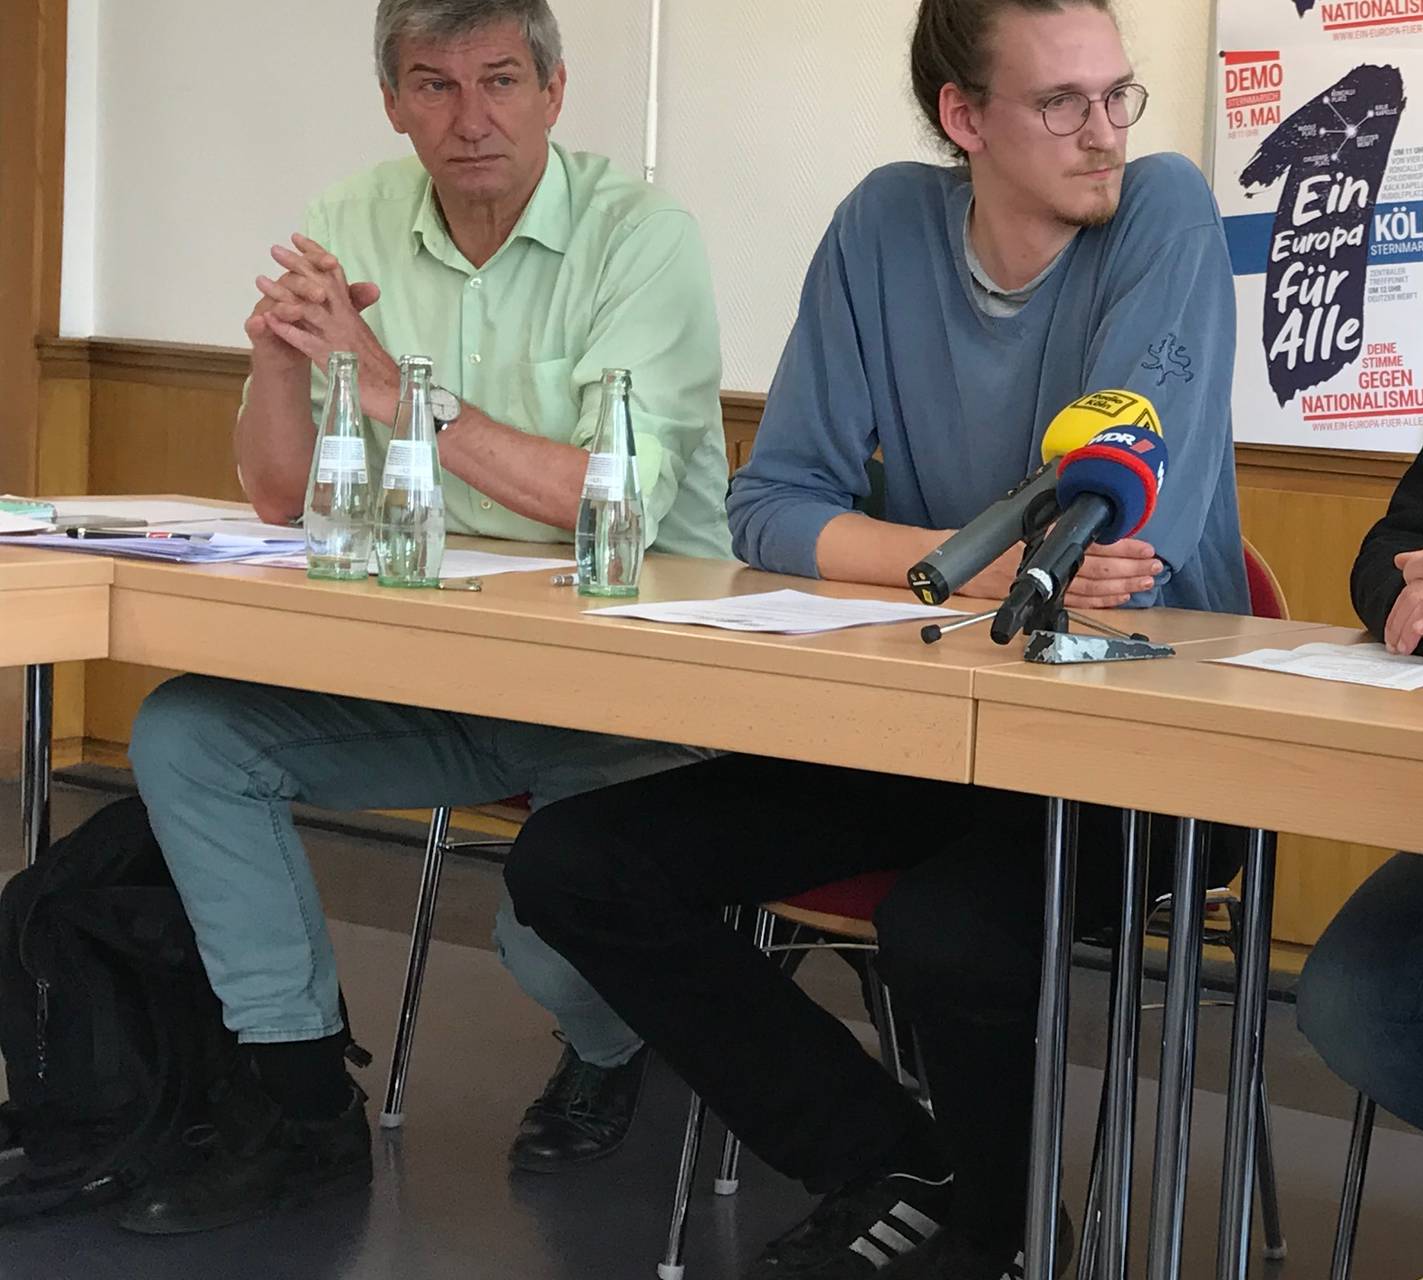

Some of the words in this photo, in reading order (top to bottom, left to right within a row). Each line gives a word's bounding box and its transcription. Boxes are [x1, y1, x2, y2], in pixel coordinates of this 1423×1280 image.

[1225, 63, 1283, 93] DEMO
[1226, 111, 1247, 130] 19.
[1250, 105, 1280, 127] MAI
[1292, 172, 1369, 227] Ein
[1271, 223, 1365, 262] Europa
[1272, 261, 1349, 313] für
[1269, 304, 1361, 370] Alle
[1367, 342, 1397, 355] DEINE
[1362, 355, 1403, 369] STIMME
[1358, 369, 1413, 389] GEGEN
